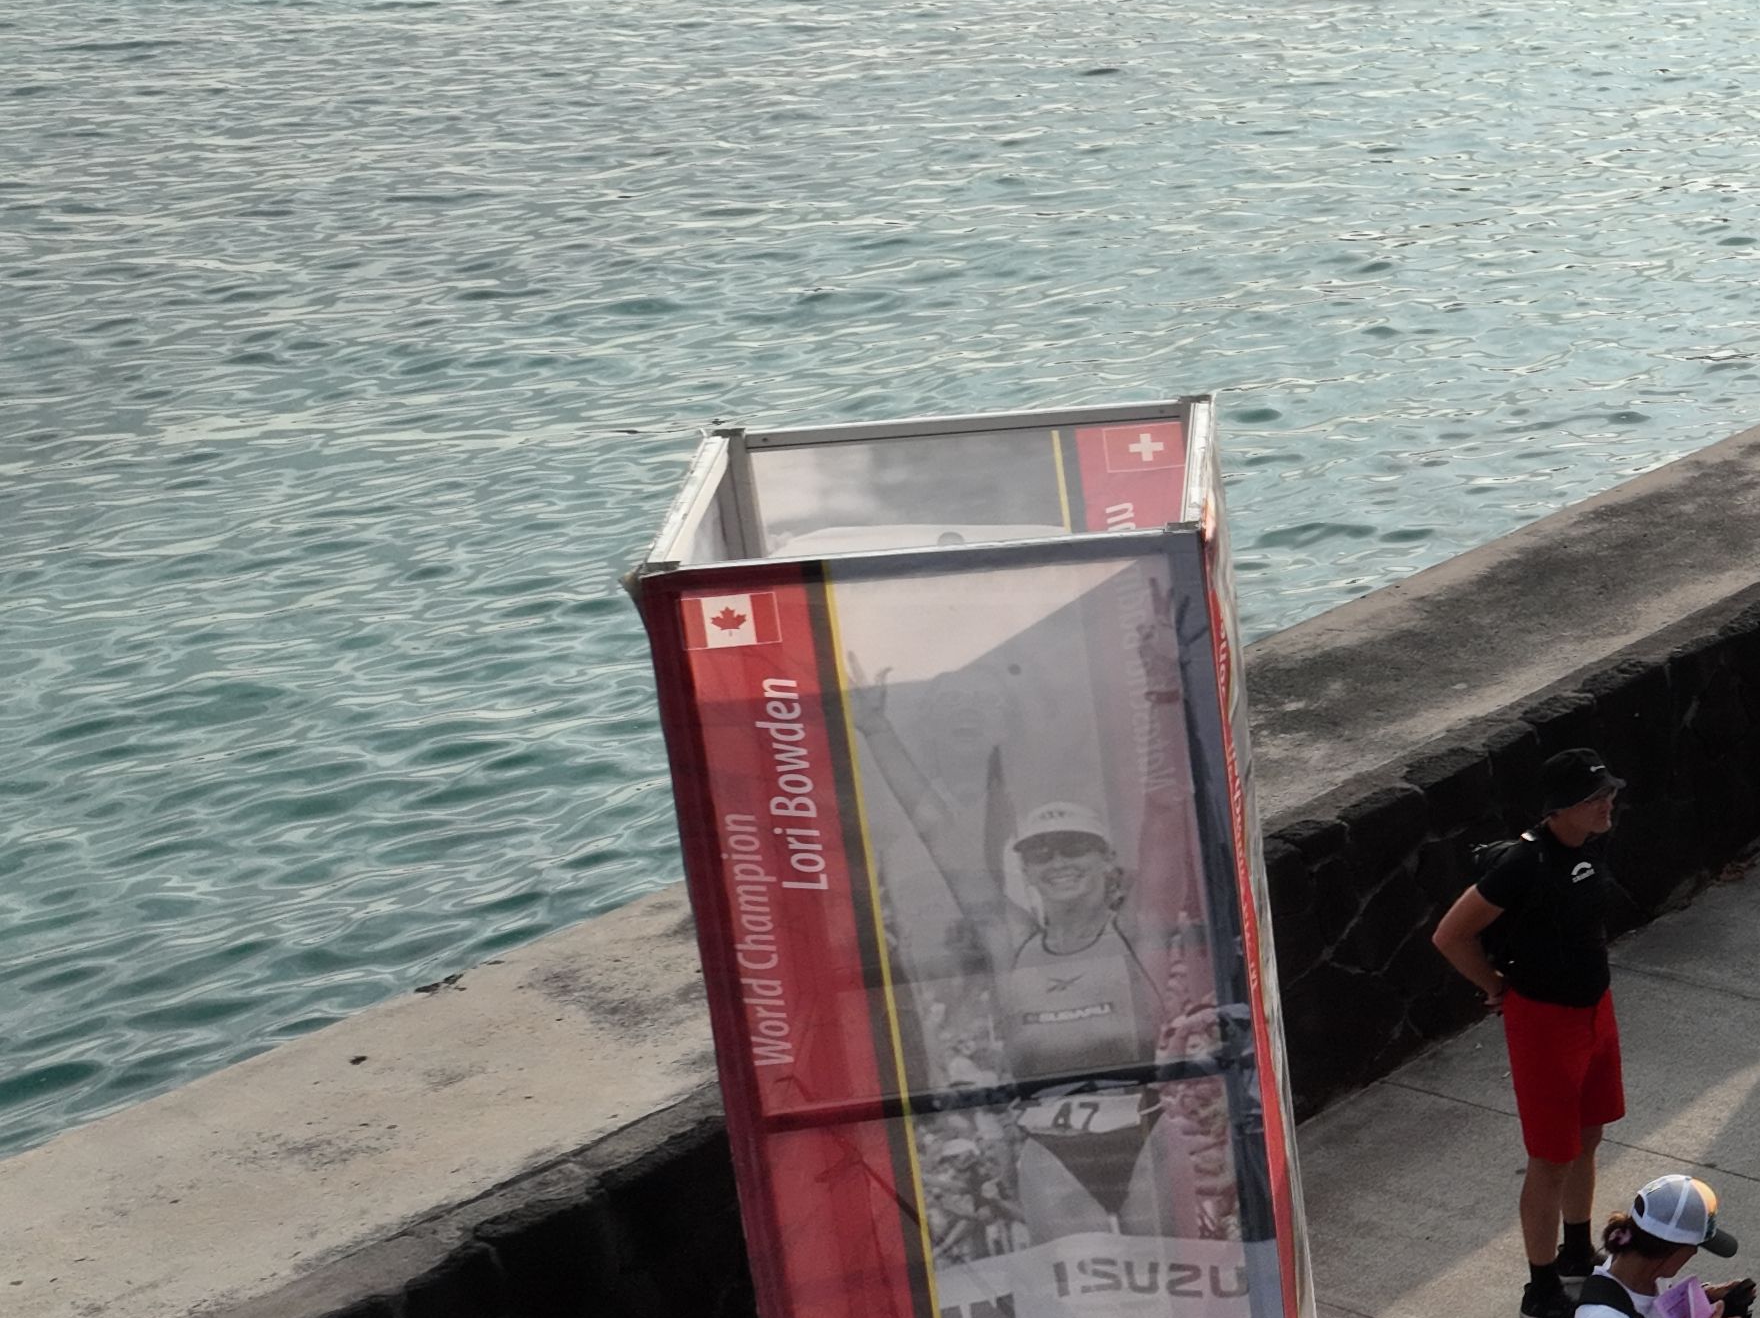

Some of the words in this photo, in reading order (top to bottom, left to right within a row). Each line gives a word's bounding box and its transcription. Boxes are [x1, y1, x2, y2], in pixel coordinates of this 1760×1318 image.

[755, 677, 817, 820] Bowden
[721, 813, 780, 971] Champion
[773, 827, 829, 891] Lori
[742, 977, 794, 1067] World
[1052, 1101, 1099, 1132] 47
[1052, 1257, 1251, 1300] ISUZU
